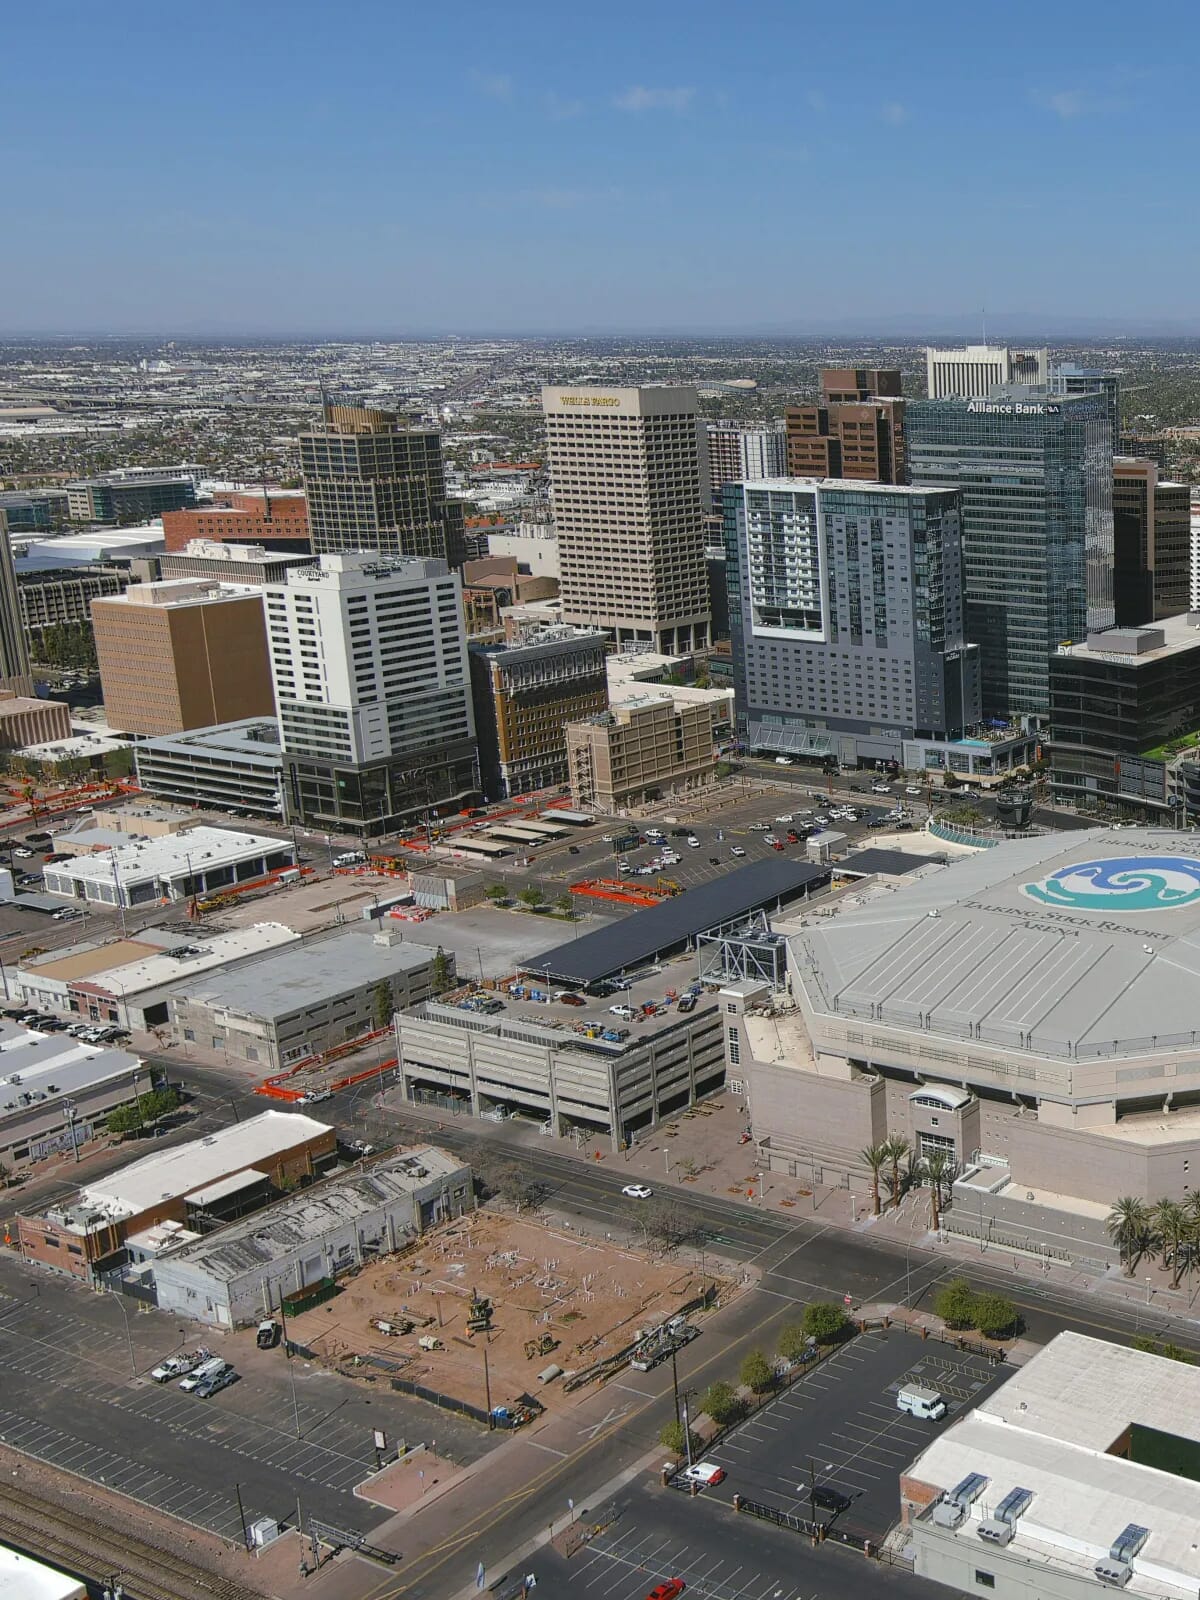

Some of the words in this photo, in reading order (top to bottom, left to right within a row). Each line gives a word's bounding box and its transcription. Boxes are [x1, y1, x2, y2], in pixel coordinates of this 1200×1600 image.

[560, 396, 590, 406] WELLS
[591, 397, 621, 407] FARGO
[967, 402, 1013, 414] Alliance
[1016, 403, 1044, 415] Bank
[297, 569, 329, 578] COURTYARD
